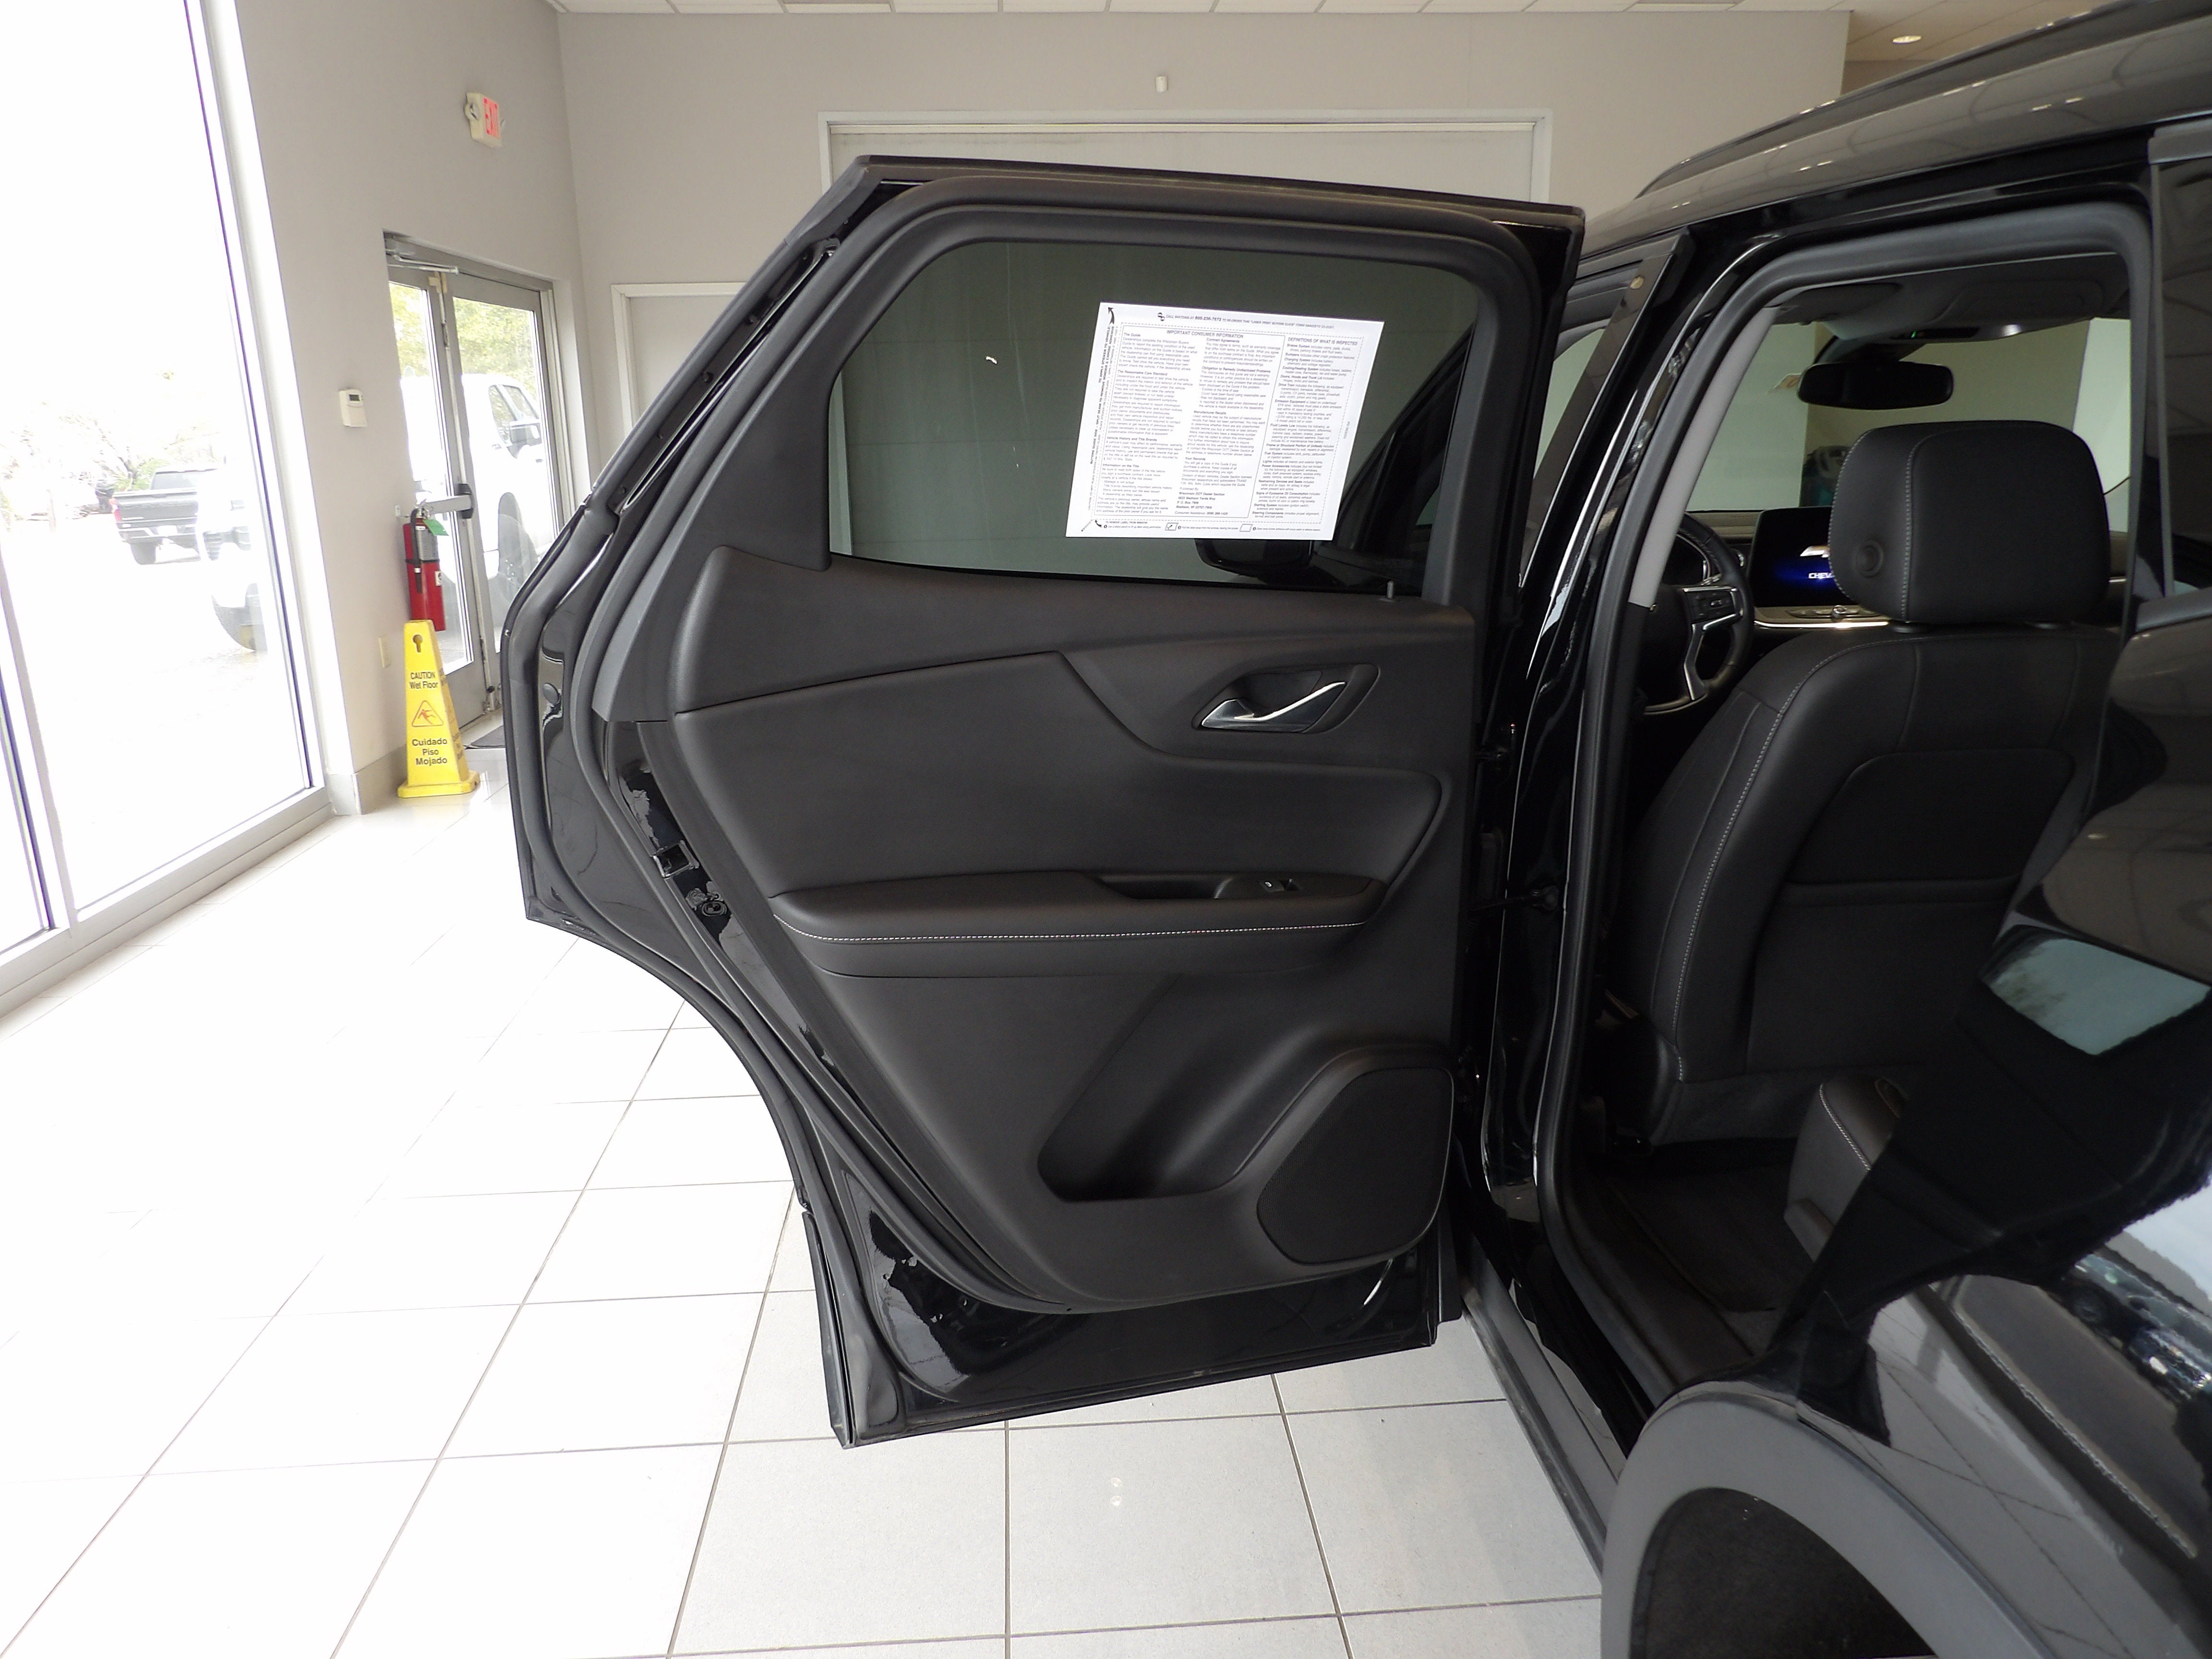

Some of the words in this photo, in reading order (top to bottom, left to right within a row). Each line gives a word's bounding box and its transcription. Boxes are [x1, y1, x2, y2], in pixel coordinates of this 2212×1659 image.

[410, 672, 435, 680] CAUTION
[412, 738, 447, 746] Cuidado
[416, 757, 447, 766] Mojado
